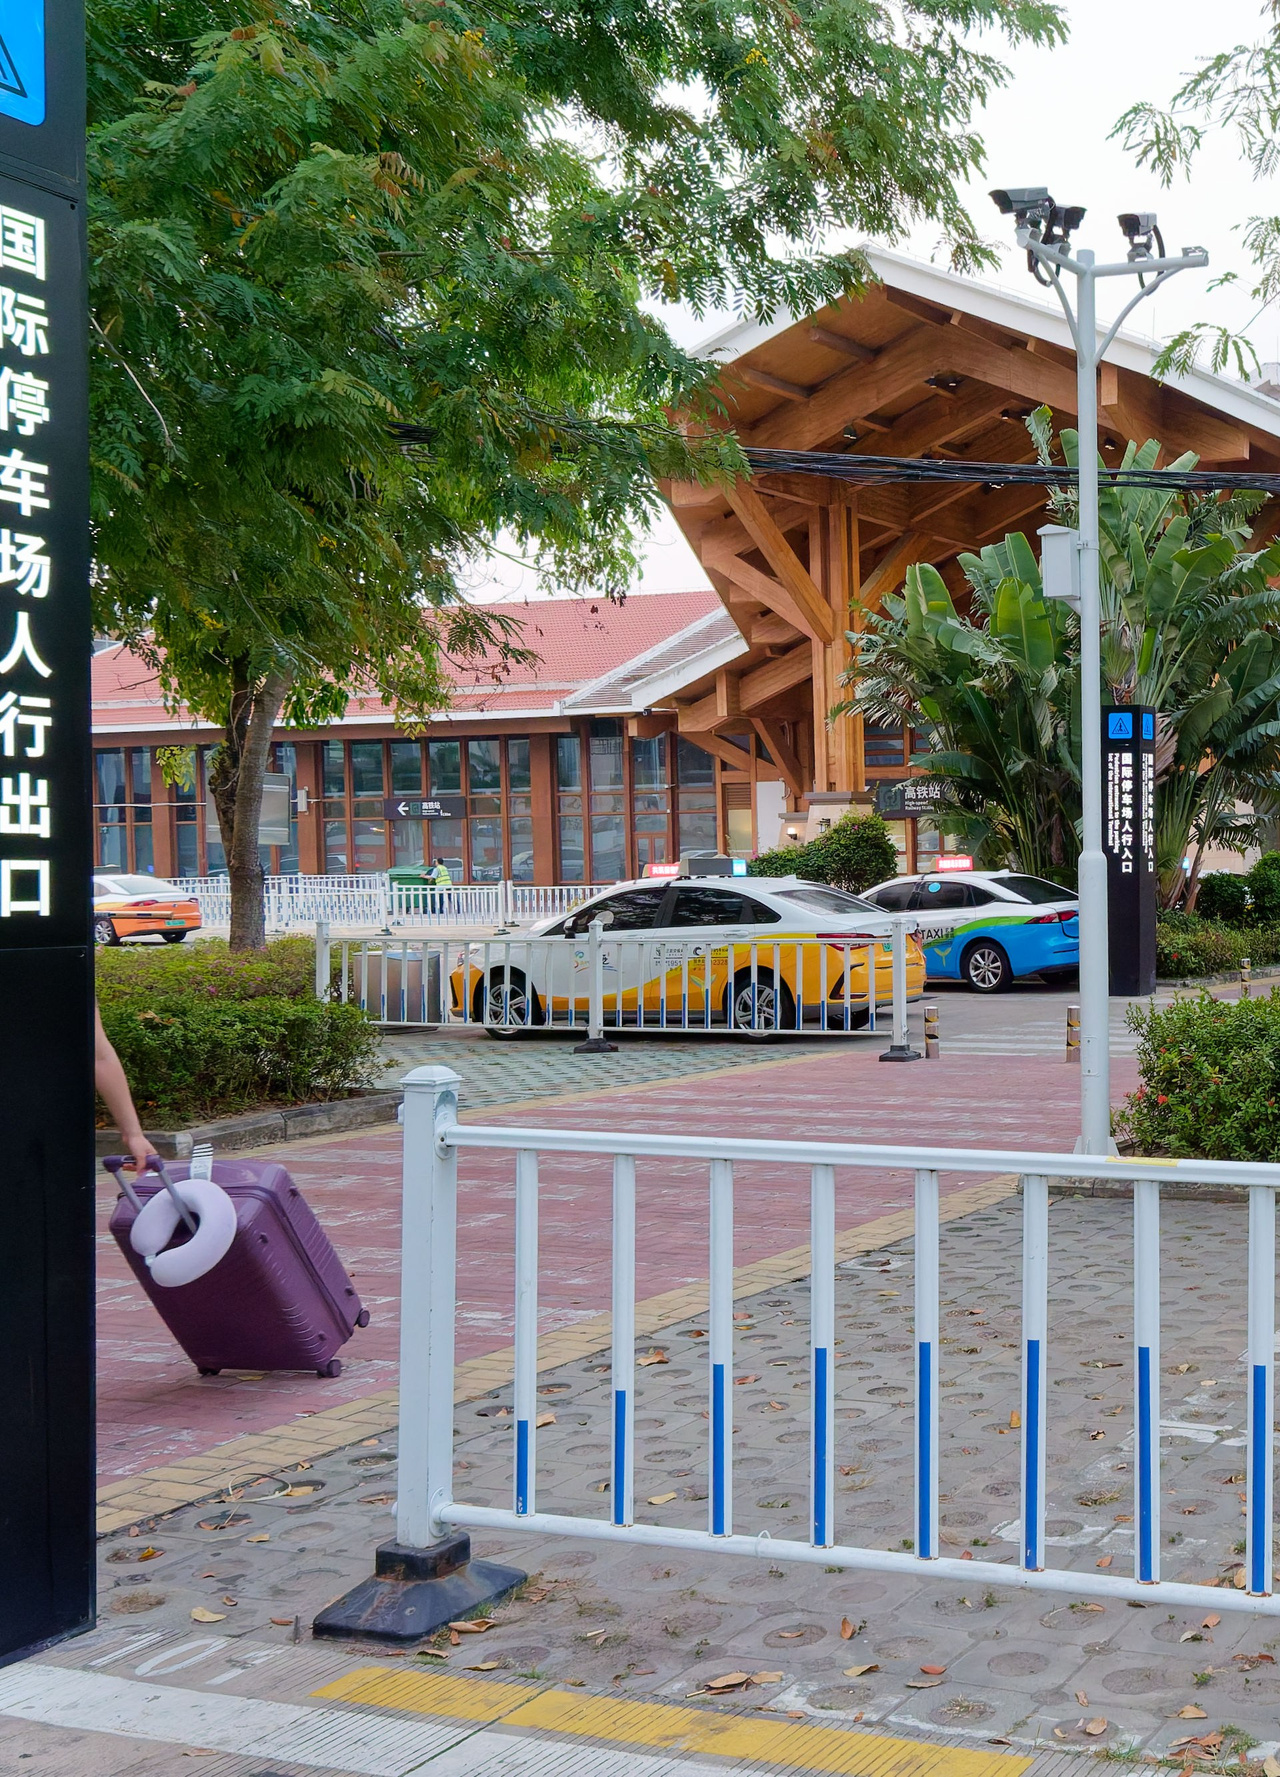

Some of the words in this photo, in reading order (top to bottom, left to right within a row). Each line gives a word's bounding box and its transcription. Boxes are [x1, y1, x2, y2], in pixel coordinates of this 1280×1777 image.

[0, 204, 53, 918] 国际停车场人行出口
[904, 786, 940, 799] 高铁站
[1121, 753, 1132, 873] 国际停车场人行入口
[921, 928, 944, 940] TAXI
